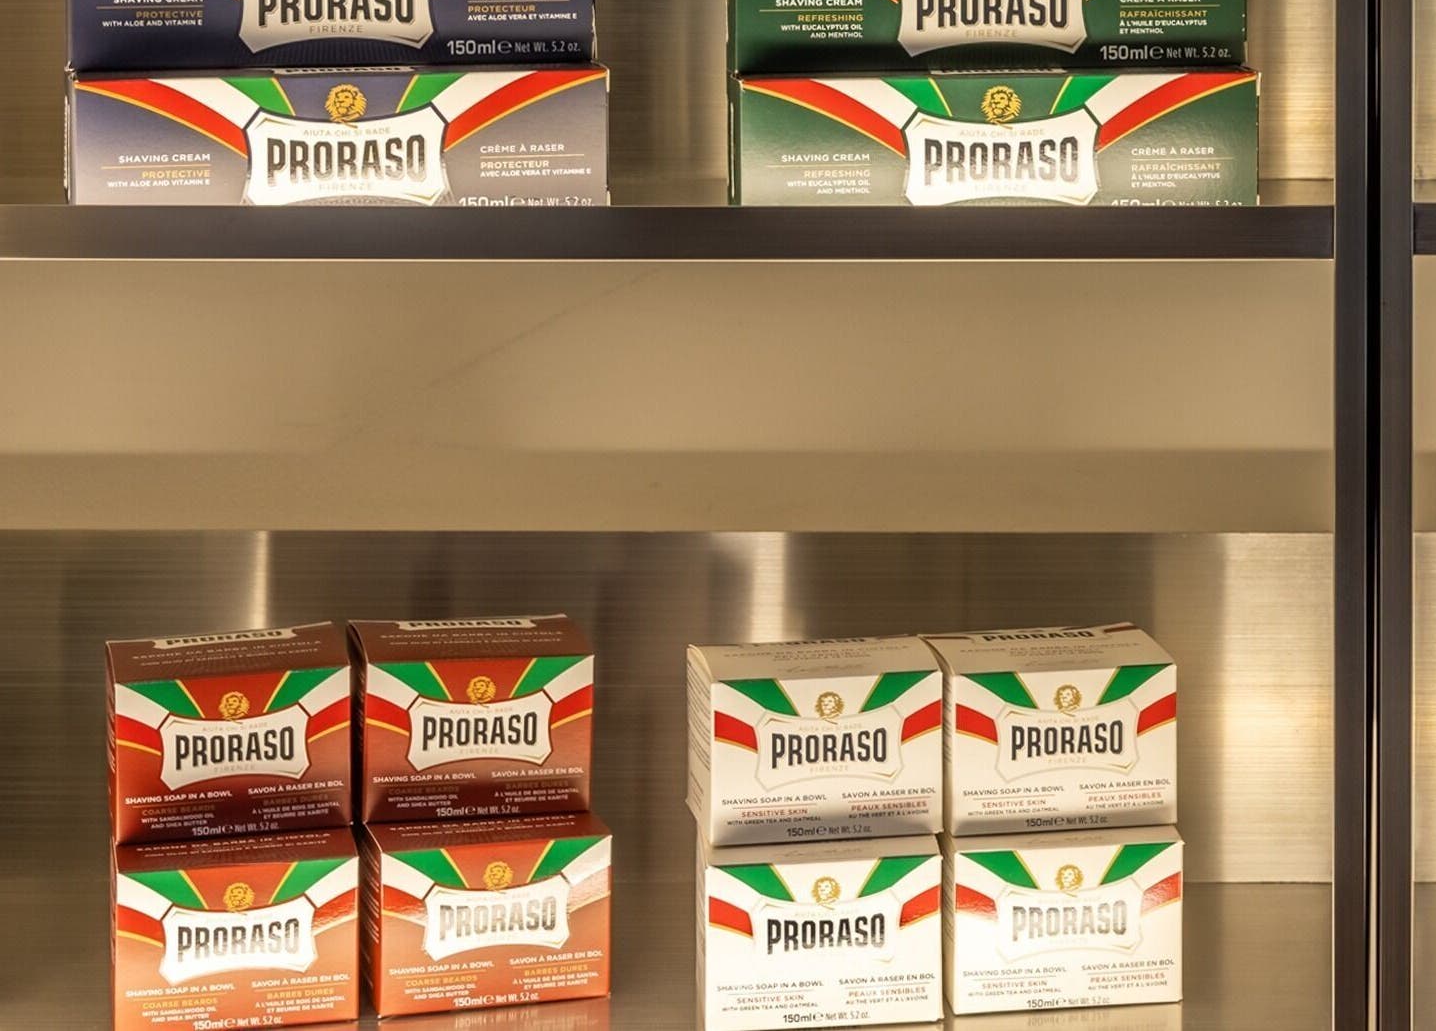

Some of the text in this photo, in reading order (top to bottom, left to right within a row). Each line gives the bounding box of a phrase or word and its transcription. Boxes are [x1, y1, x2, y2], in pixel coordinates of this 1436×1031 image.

[136, 10, 204, 18] PROTECTIVE
[798, 14, 863, 22] REFRESHING
[309, 24, 364, 33] FIRENZE
[966, 28, 1017, 38] FIRENZE
[515, 42, 530, 52] Net
[534, 42, 549, 52] Wt.
[552, 41, 565, 52] 5.2
[568, 41, 581, 51] oz.
[1166, 47, 1182, 58] Net
[1185, 47, 1199, 58] Wt.
[1203, 46, 1215, 57] 5.2
[1218, 48, 1231, 57] oz.
[480, 144, 515, 154] CRÈME
[519, 144, 527, 152] À
[119, 154, 211, 163] SHAVING CREAM
[266, 134, 426, 187] PRORASO
[480, 160, 549, 168] PROTECTEUR
[782, 154, 870, 163] SHAVING CREAM
[924, 135, 1079, 187] PRORASO
[142, 170, 211, 178] PROTECTIVE
[422, 712, 538, 751] PRORASO
[1011, 720, 1123, 760] PRORASO
[175, 725, 295, 770] PRORASO
[771, 727, 887, 769] PRORASO
[842, 790, 870, 799] SAVON
[880, 789, 906, 797] RASER
[921, 786, 936, 795] BOL
[722, 798, 758, 806] SHAVING
[761, 796, 782, 804] SOAP
[803, 793, 826, 801] BOWL
[851, 801, 927, 812] PEAUX SENSIBLES
[742, 809, 786, 818] SENSITIVE
[440, 896, 556, 941] PRORASO
[1012, 900, 1127, 942] PRORASO
[177, 917, 299, 963] PRORASO
[767, 913, 885, 955] PRORASO
